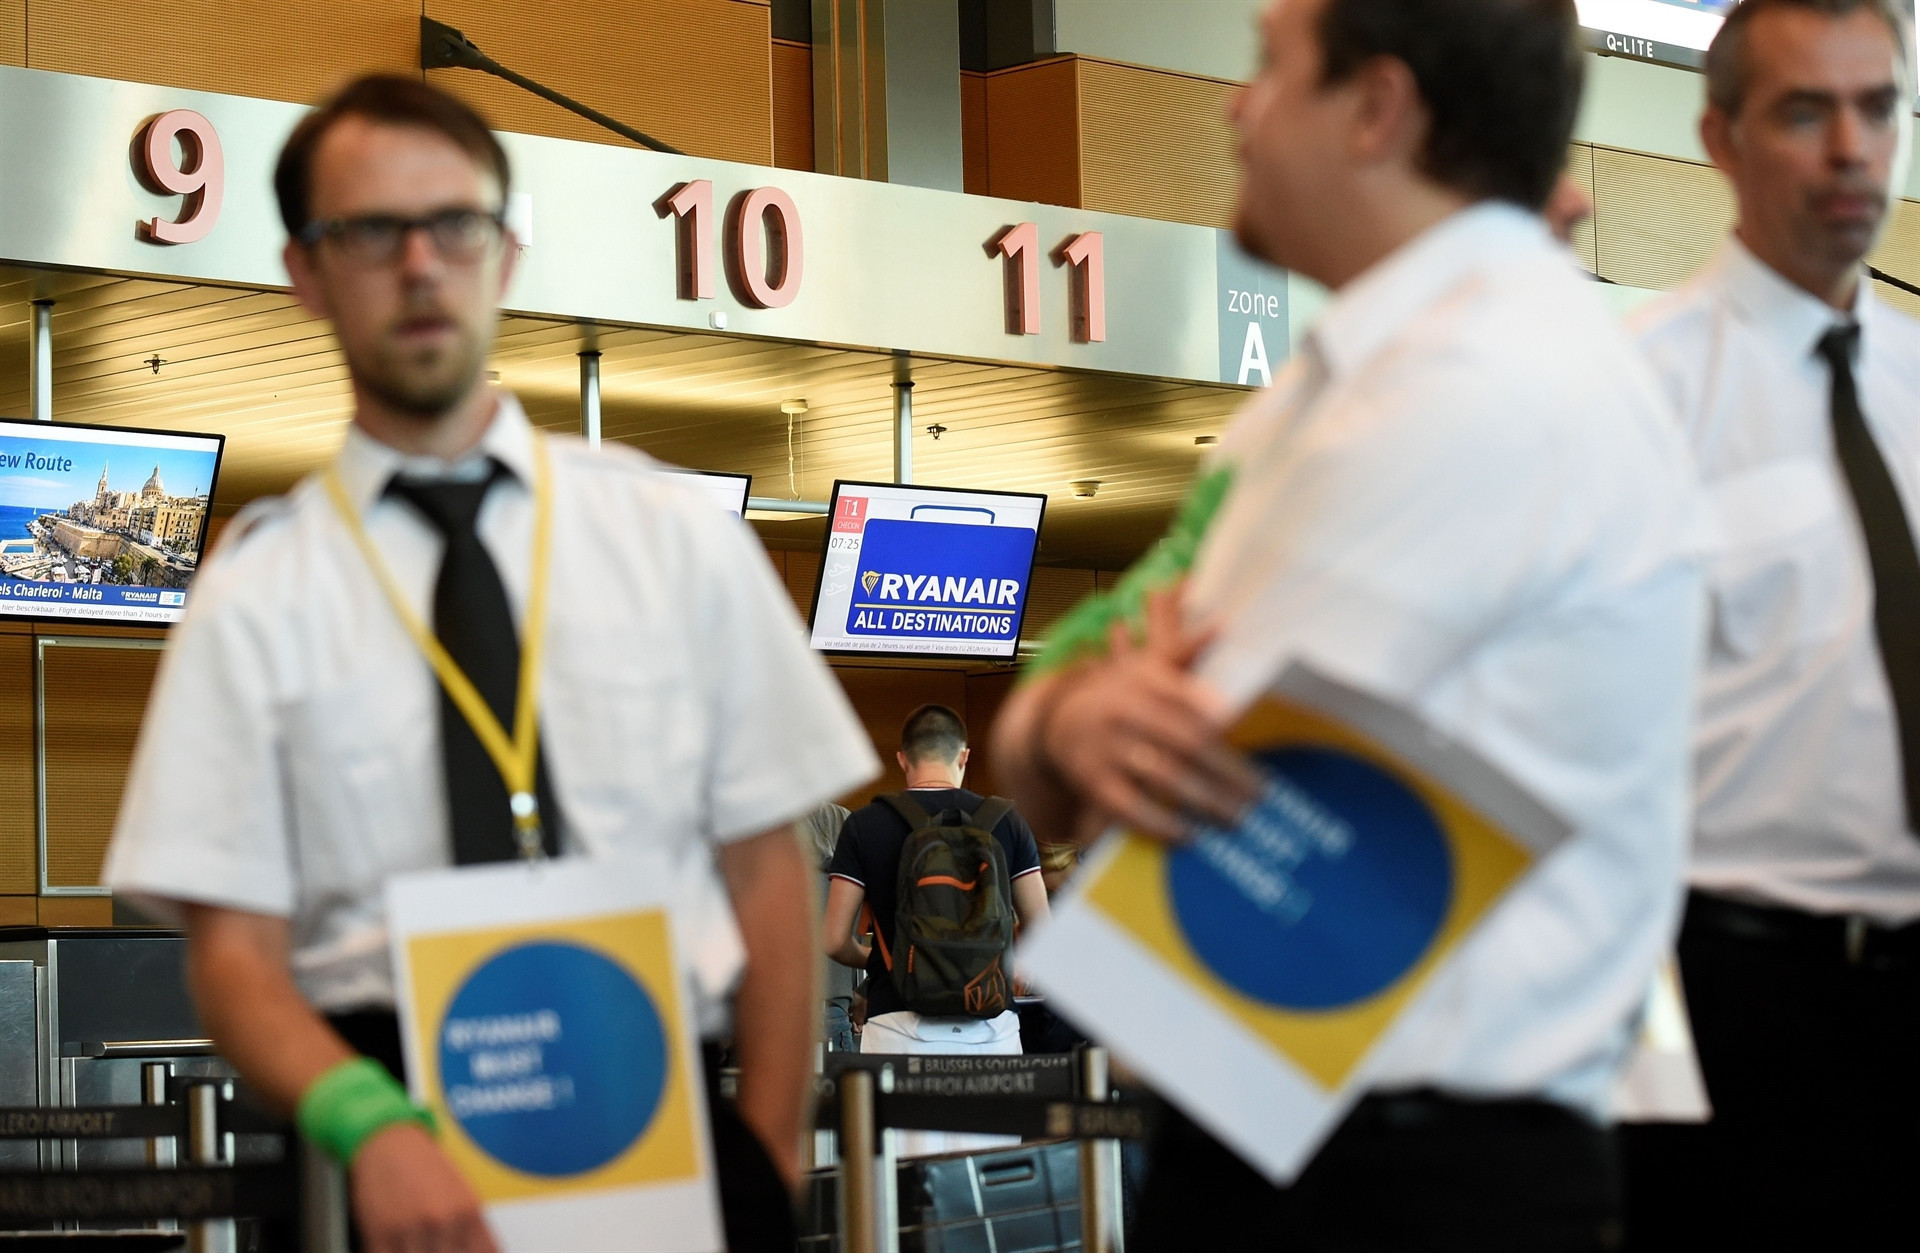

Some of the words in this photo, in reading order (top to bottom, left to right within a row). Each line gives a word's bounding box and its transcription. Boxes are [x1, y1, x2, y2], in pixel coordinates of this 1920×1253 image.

[1606, 34, 1654, 57] Q-LITE
[144, 109, 224, 244] 9
[667, 179, 804, 309] 10
[999, 222, 1106, 342] 11
[1228, 289, 1279, 318] zone
[1237, 321, 1273, 388] A
[25, 452, 72, 472] Route
[844, 499, 859, 516] T1
[831, 537, 860, 550] 07:25
[14, 583, 63, 599] Charleroi
[72, 586, 103, 600] Malta
[125, 591, 158, 600] RYANAIR
[880, 573, 1020, 606] RYANAIR
[1, 604, 14, 612] hier
[59, 606, 77, 615] Flight
[78, 607, 103, 617] delayed
[123, 609, 138, 617] than
[139, 610, 144, 618] 2
[145, 611, 162, 619] hours
[854, 610, 887, 629] ALL
[891, 611, 1012, 635] DESTINATIONS
